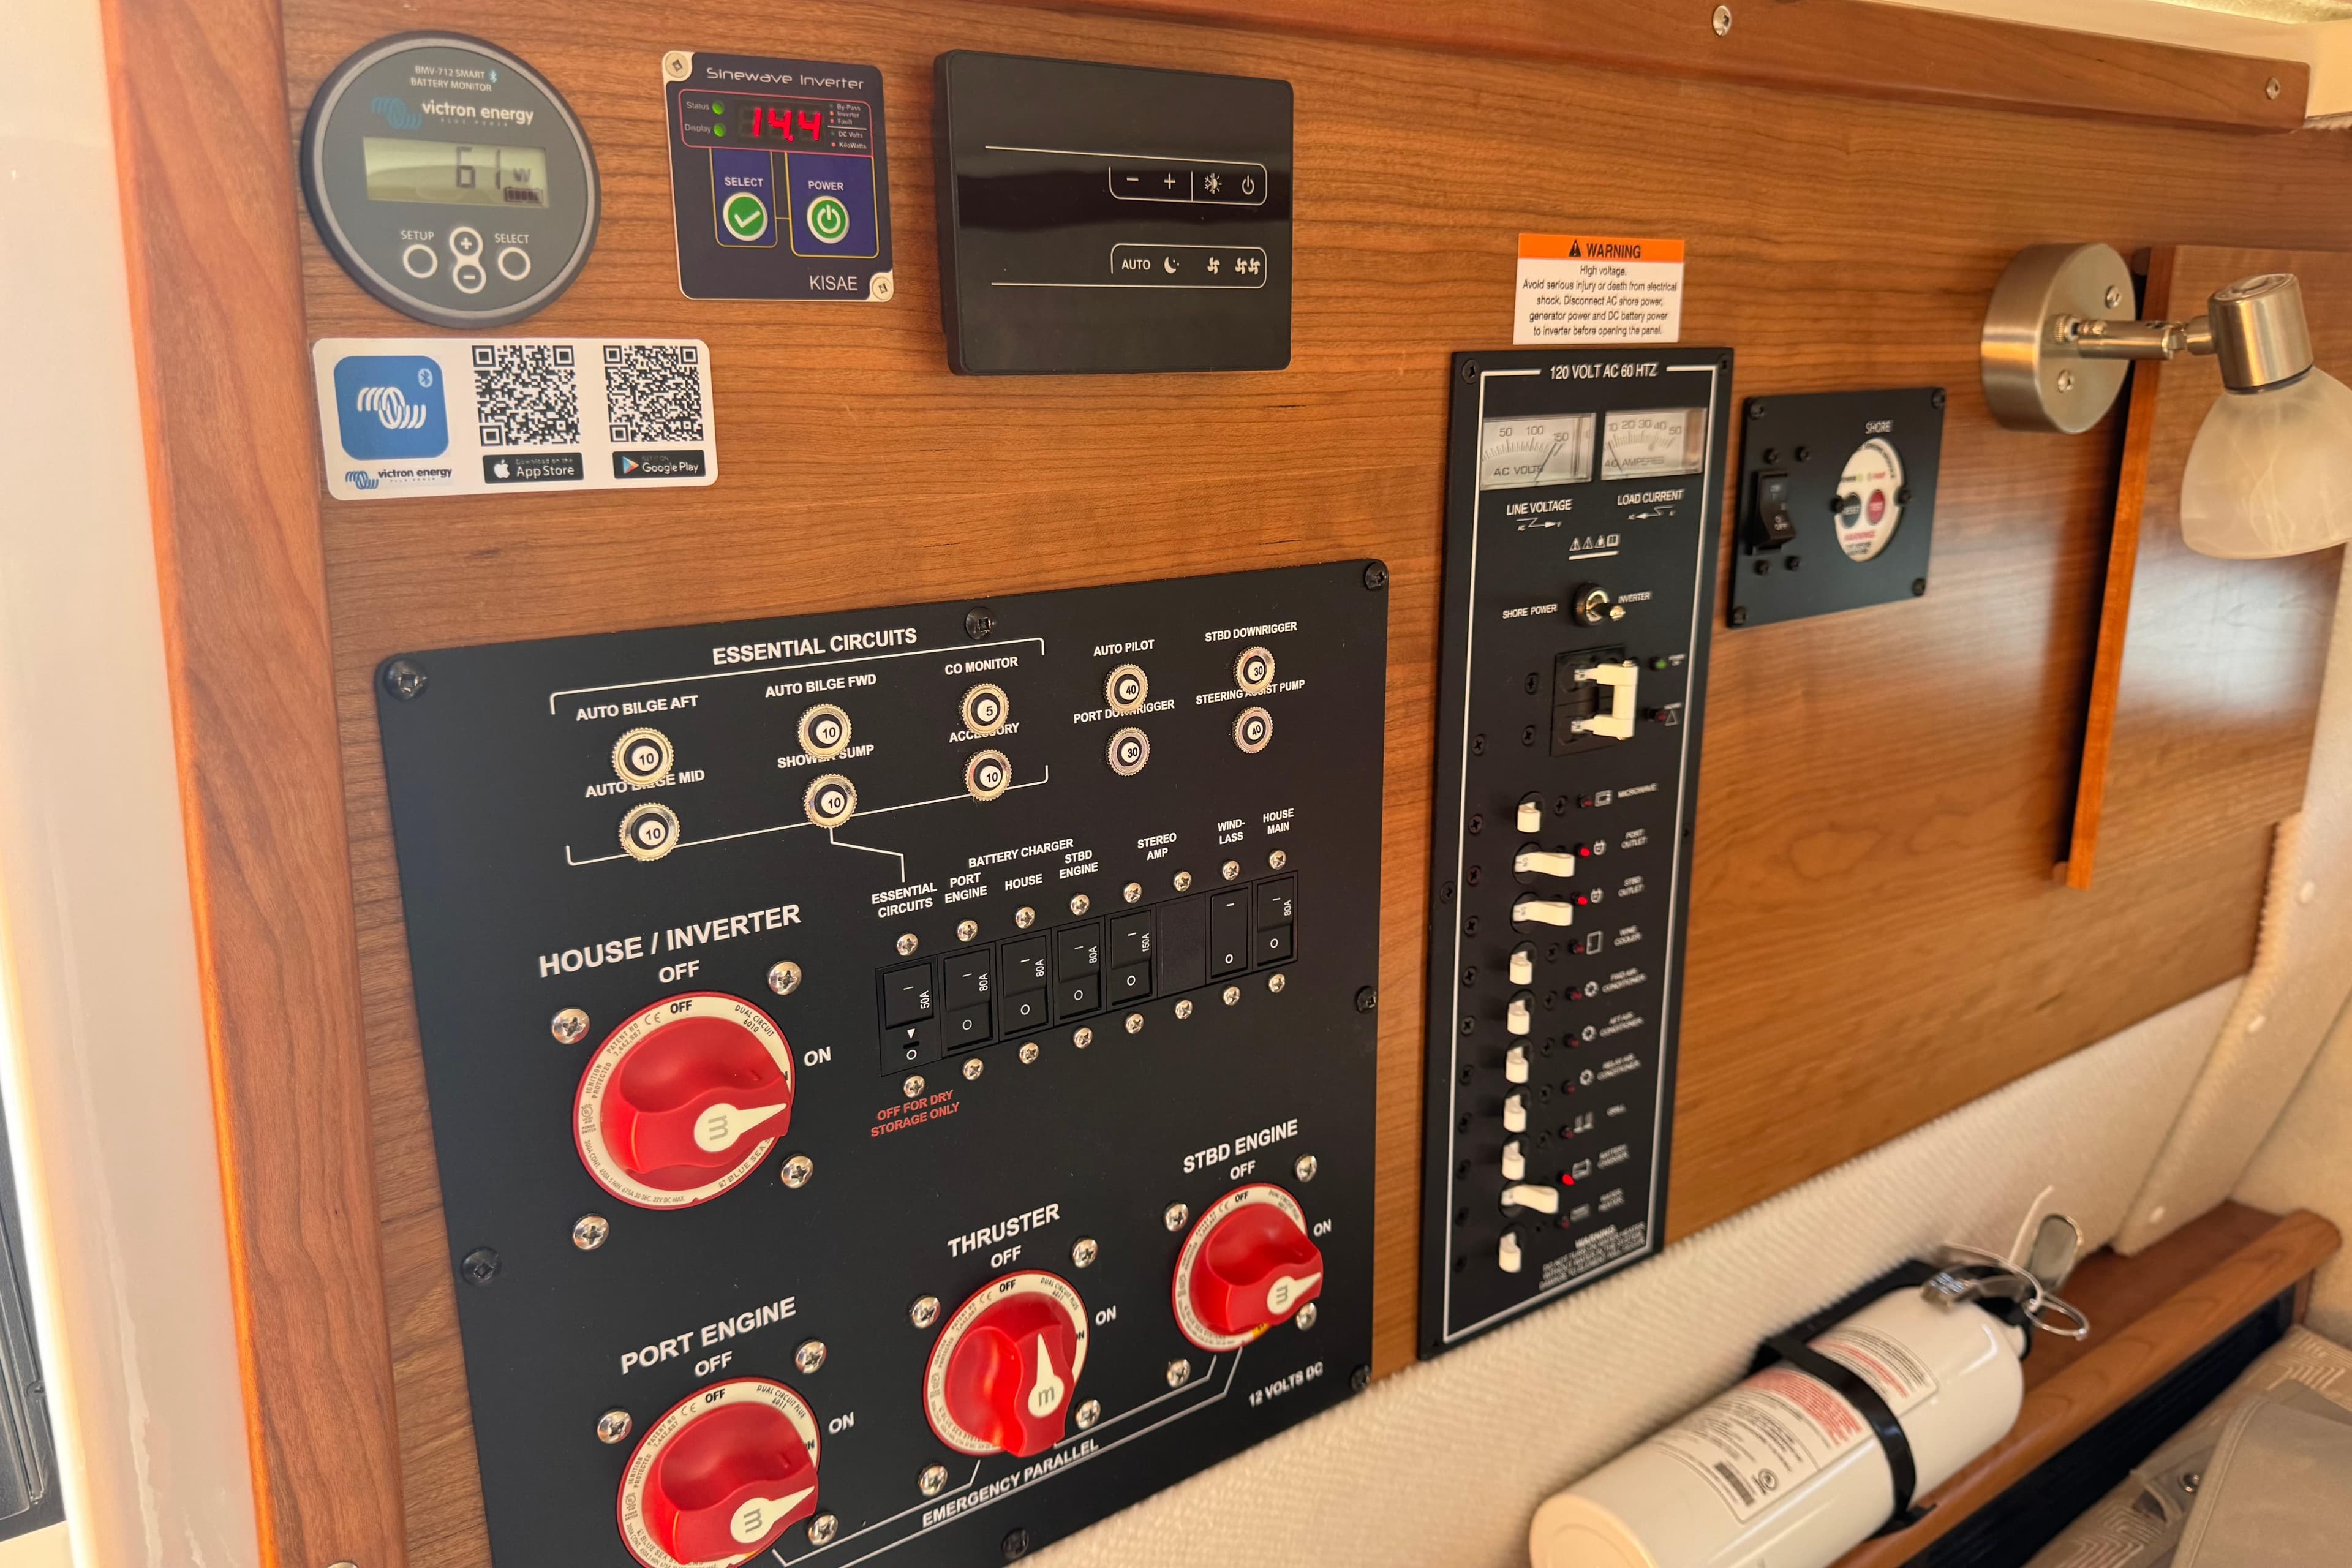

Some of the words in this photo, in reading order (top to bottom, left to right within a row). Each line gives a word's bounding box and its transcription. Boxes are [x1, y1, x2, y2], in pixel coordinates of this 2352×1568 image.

[415, 66, 453, 77] BMV-712
[455, 70, 485, 79] SMART
[706, 67, 793, 85] Sinewave
[800, 74, 864, 90] Inverter
[410, 78, 448, 88] BATTERY
[451, 81, 492, 91] MONITOR
[422, 100, 476, 118] victron
[481, 107, 534, 125] energy
[686, 102, 709, 110] Status
[685, 124, 711, 133] Display
[753, 108, 821, 142] 14.4
[725, 177, 764, 187] SELECT
[808, 181, 844, 191] POWER
[401, 230, 434, 241] SETUP
[495, 233, 529, 244] SELECT
[1586, 243, 1641, 258] WARNING
[1121, 259, 1151, 271] AUTO
[1580, 265, 1597, 277] High
[1599, 266, 1627, 277] voltage.
[810, 276, 858, 292] KISAE
[1523, 280, 1544, 290] Avoid
[1546, 281, 1574, 290] serious
[1576, 281, 1596, 292] injury
[1607, 281, 1627, 292] death
[1629, 282, 1645, 292] from
[1647, 282, 1677, 292] electrical
[1537, 295, 1561, 306] shock.
[1564, 296, 1604, 306] Disconnect
[1605, 296, 1617, 306] AC
[1619, 296, 1638, 306] shore
[1529, 312, 1566, 322] generator
[1568, 312, 1591, 322] power
[1593, 311, 1606, 320] and
[1608, 311, 1619, 320] DC
[1621, 311, 1645, 322] battery
[1646, 312, 1667, 322] power
[1534, 327, 1541, 336] to
[1543, 326, 1571, 336] inverter
[1573, 326, 1596, 336] before
[1598, 326, 1627, 337] opening
[1629, 326, 1640, 336] the
[1550, 366, 1568, 380] 120
[1572, 364, 1601, 379] VOLT
[1604, 364, 1619, 378] AC
[1621, 363, 1634, 377] 60
[1635, 361, 1659, 377] HTZ
[1526, 426, 1544, 435] 100
[1622, 420, 1635, 429] 20
[1638, 420, 1651, 428] 30
[1865, 420, 1892, 434] SHORE
[1499, 428, 1512, 437] 50
[1553, 433, 1569, 442] 150
[378, 469, 414, 478] victron
[417, 468, 452, 478] energy
[517, 466, 545, 479] App
[546, 465, 575, 476] Store
[642, 462, 677, 474] Google
[679, 462, 698, 473] Play
[1494, 467, 1509, 476] AC
[1514, 465, 1544, 474] VOLTS
[1617, 494, 1642, 505] LOAD
[1643, 489, 1684, 503] CURRENT
[1507, 503, 1528, 516] LINE
[1530, 499, 1573, 513] VOLTAGE
[1618, 592, 1653, 603] INVERTER
[1502, 608, 1528, 619] SHORE
[1531, 604, 1558, 615] POWER
[1205, 629, 1231, 643] STBD
[1234, 621, 1297, 639] DOWNRIGGER
[712, 638, 826, 665] ESSENTIAL
[830, 627, 918, 652] CIRCUITS
[1093, 643, 1123, 657] AUTO
[1125, 639, 1155, 654] PILOT
[944, 663, 963, 676] CO
[965, 656, 1019, 674] MONITOR
[1254, 666, 1263, 676] 30
[765, 683, 803, 698] AUTO
[806, 678, 846, 693] BILGE
[848, 674, 877, 688] FWD
[1126, 685, 1136, 695] 40
[1196, 689, 1243, 704] STEERING
[1280, 680, 1305, 692] PUMP
[576, 704, 619, 722] AUTO
[622, 699, 668, 715] BILGE
[670, 695, 699, 709] AFT
[986, 706, 993, 716] 5
[823, 727, 836, 739] 10
[1252, 725, 1261, 736] 40
[639, 753, 654, 766] 10
[1128, 747, 1137, 758] 30
[585, 782, 628, 798] AUTO
[679, 770, 705, 784] MID
[1263, 809, 1294, 823] HOUSE
[1218, 819, 1245, 832] WIND-
[1267, 822, 1289, 835] MAIN
[1137, 833, 1177, 849] STEREO
[1219, 832, 1243, 845] LASS
[1621, 836, 1648, 850] OUTLET
[968, 849, 1019, 869] BATTERY
[1021, 838, 1074, 858] CHARGER
[1065, 850, 1093, 864] STBD
[1147, 848, 1168, 861] AMP
[1059, 862, 1098, 880] ENGINE
[950, 872, 981, 888] PORT
[1005, 873, 1042, 891] HOUSE
[872, 882, 937, 905] ESSENTIAL
[945, 885, 987, 904] ENGINE
[1618, 884, 1645, 897] OUTLET
[878, 898, 933, 918] CIRCUITS
[538, 937, 644, 978] HOUSE
[666, 904, 802, 951] INVERTER
[658, 960, 700, 983] OFF
[921, 990, 930, 1009] 50A
[670, 1000, 692, 1014] OFF
[735, 1005, 751, 1018] DUAL
[753, 1016, 774, 1037] CIRCUIT
[744, 1019, 759, 1033] 6010
[804, 1047, 832, 1067] ON
[877, 1105, 900, 1121] OFF
[903, 1098, 927, 1114] FOR
[930, 1090, 954, 1106] DRY
[871, 1113, 927, 1138] STORAGE
[930, 1102, 960, 1119] ONLY
[1183, 1142, 1231, 1175] STBD
[1235, 1118, 1298, 1157] ENGINE
[1229, 1160, 1256, 1180] OFF
[1235, 1191, 1249, 1204] OFF
[948, 1202, 1060, 1258] THRUSTER
[1313, 1219, 1332, 1237] ON
[990, 1245, 1022, 1268] OFF
[999, 1279, 1016, 1293] OFF
[1095, 1306, 1117, 1326] ON
[620, 1332, 695, 1376] PORT
[701, 1296, 796, 1348] ENGINE
[695, 1351, 733, 1378] OFF
[1249, 1388, 1263, 1408] 12
[1264, 1367, 1304, 1401] VOLTS
[1305, 1361, 1324, 1382] DC
[705, 1389, 726, 1403] OFF
[828, 1411, 855, 1434] ON
[922, 1470, 1020, 1528] EMERGENCY
[1023, 1438, 1099, 1482] PARALLEL
